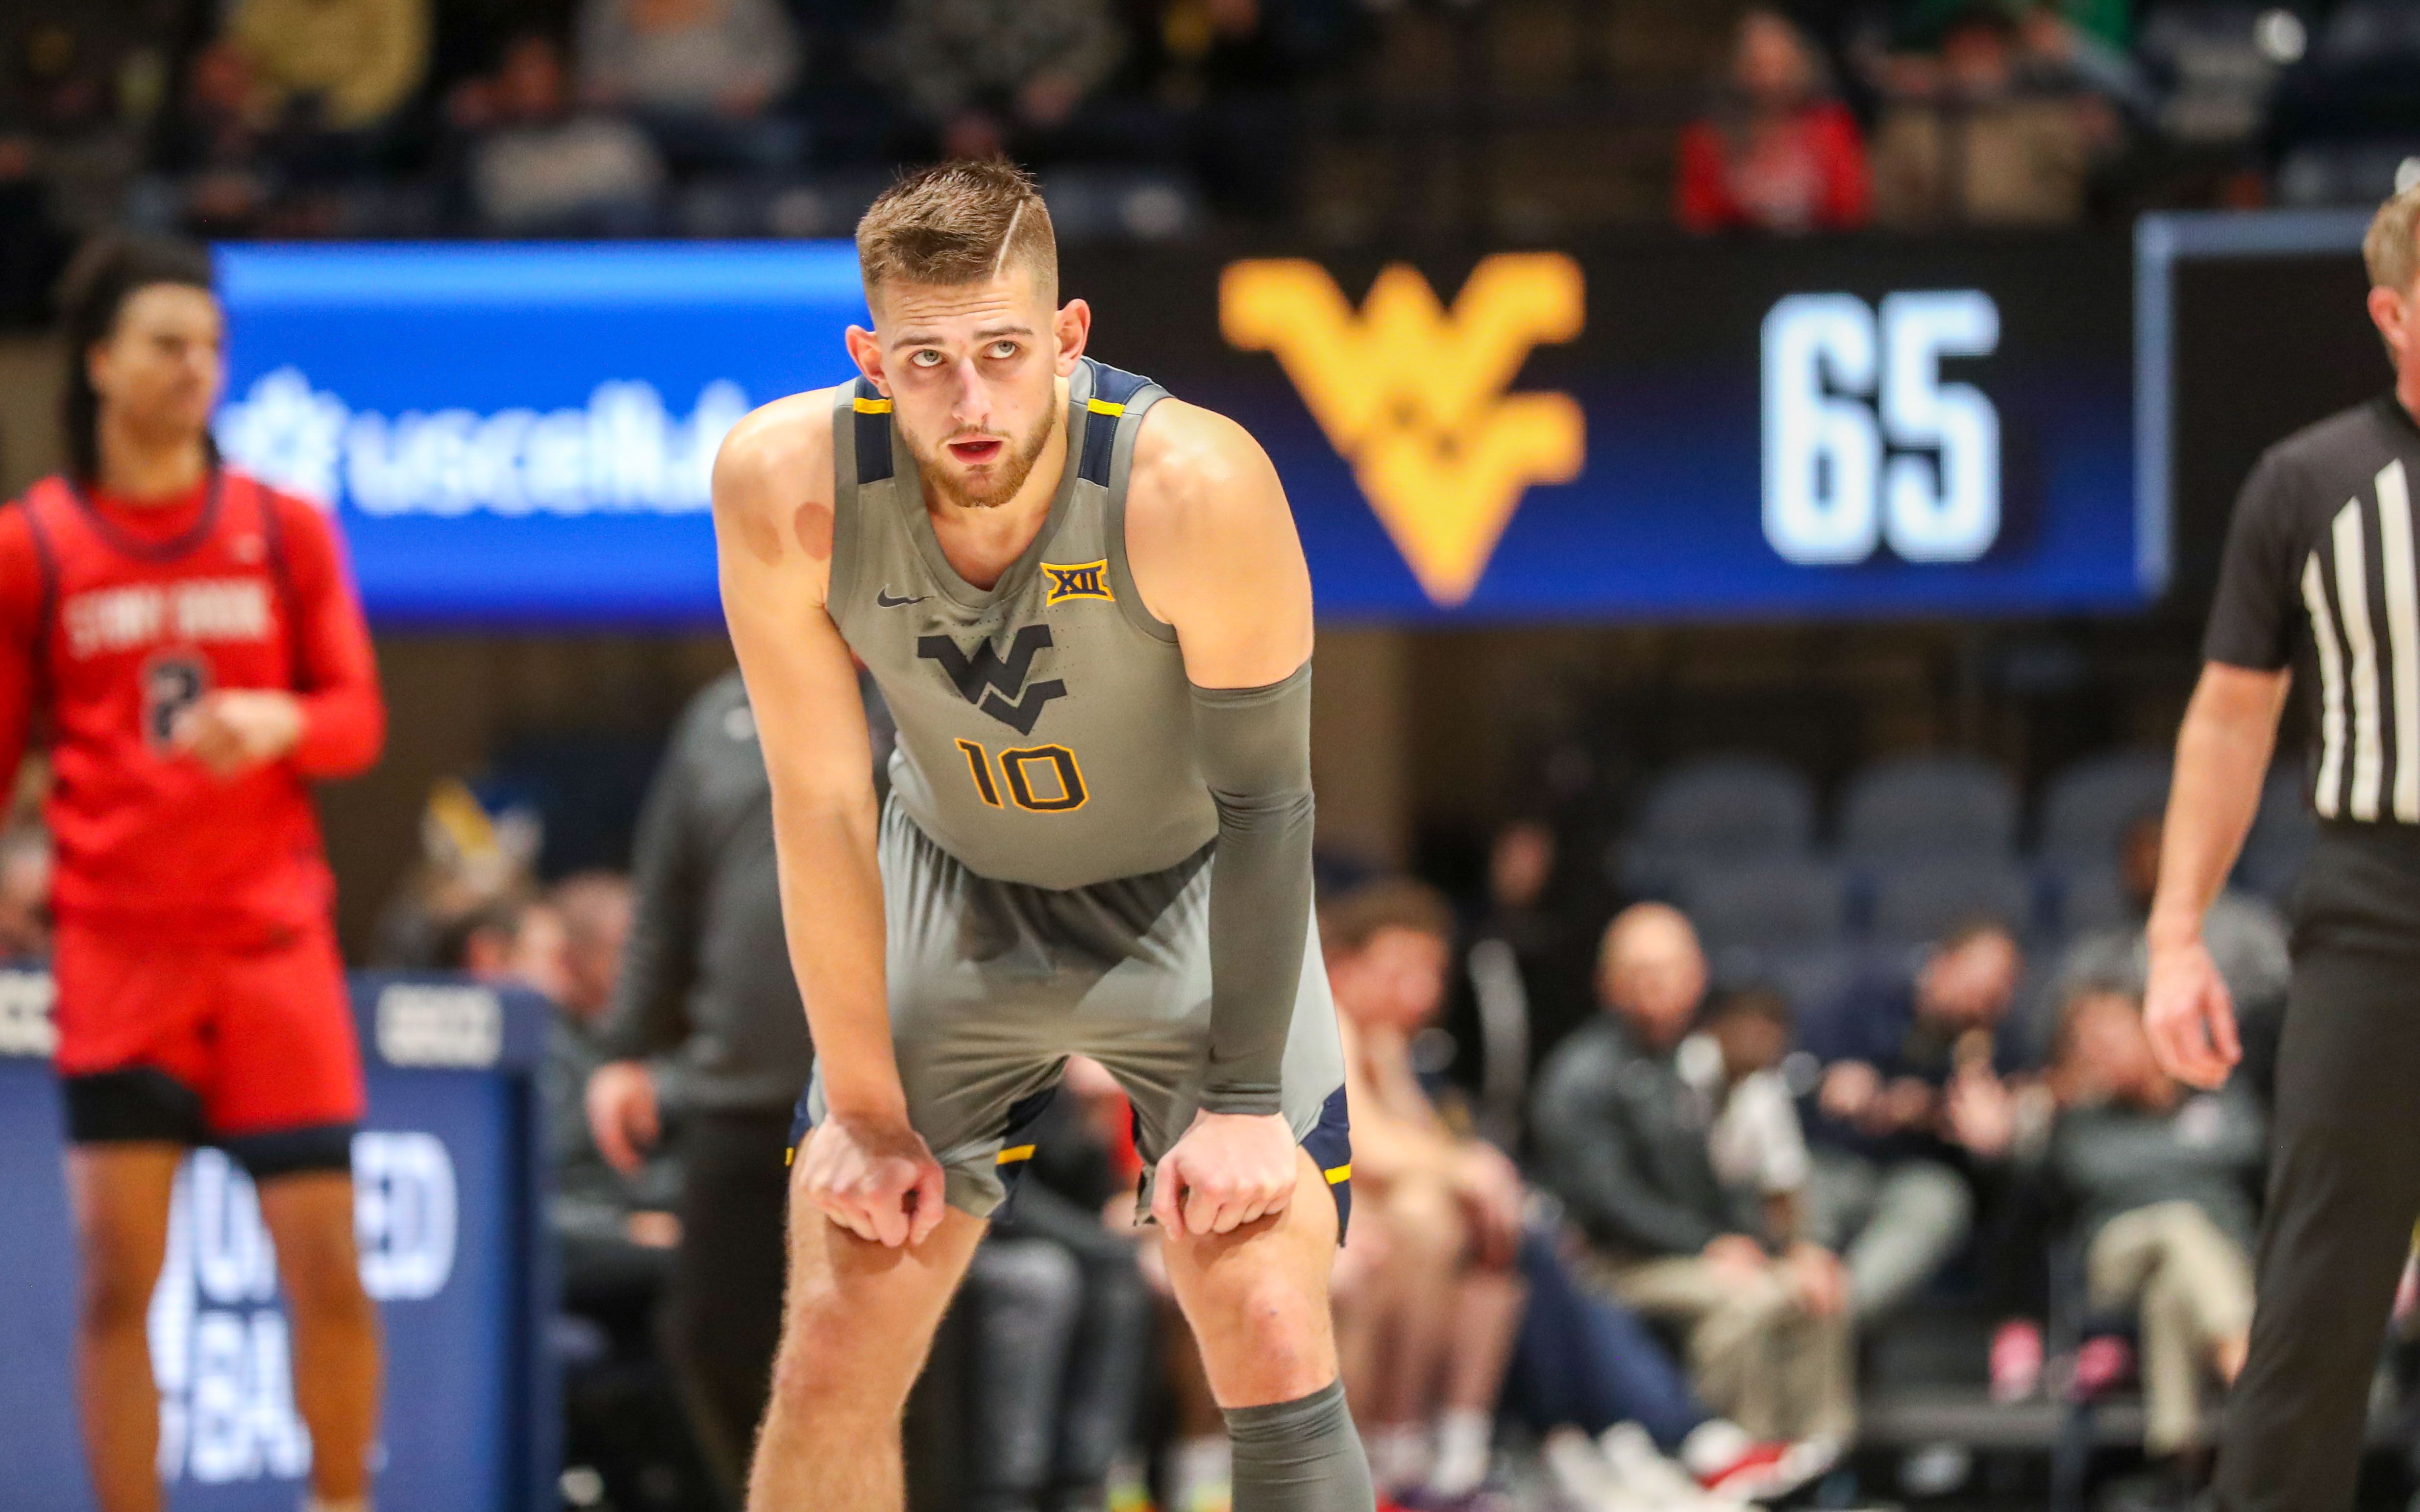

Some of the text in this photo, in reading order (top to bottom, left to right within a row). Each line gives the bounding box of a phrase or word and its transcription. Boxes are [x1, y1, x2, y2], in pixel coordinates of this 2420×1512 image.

[1761, 290, 2000, 564] 65
[1047, 565, 1108, 600] XII
[955, 738, 1090, 813] 10
